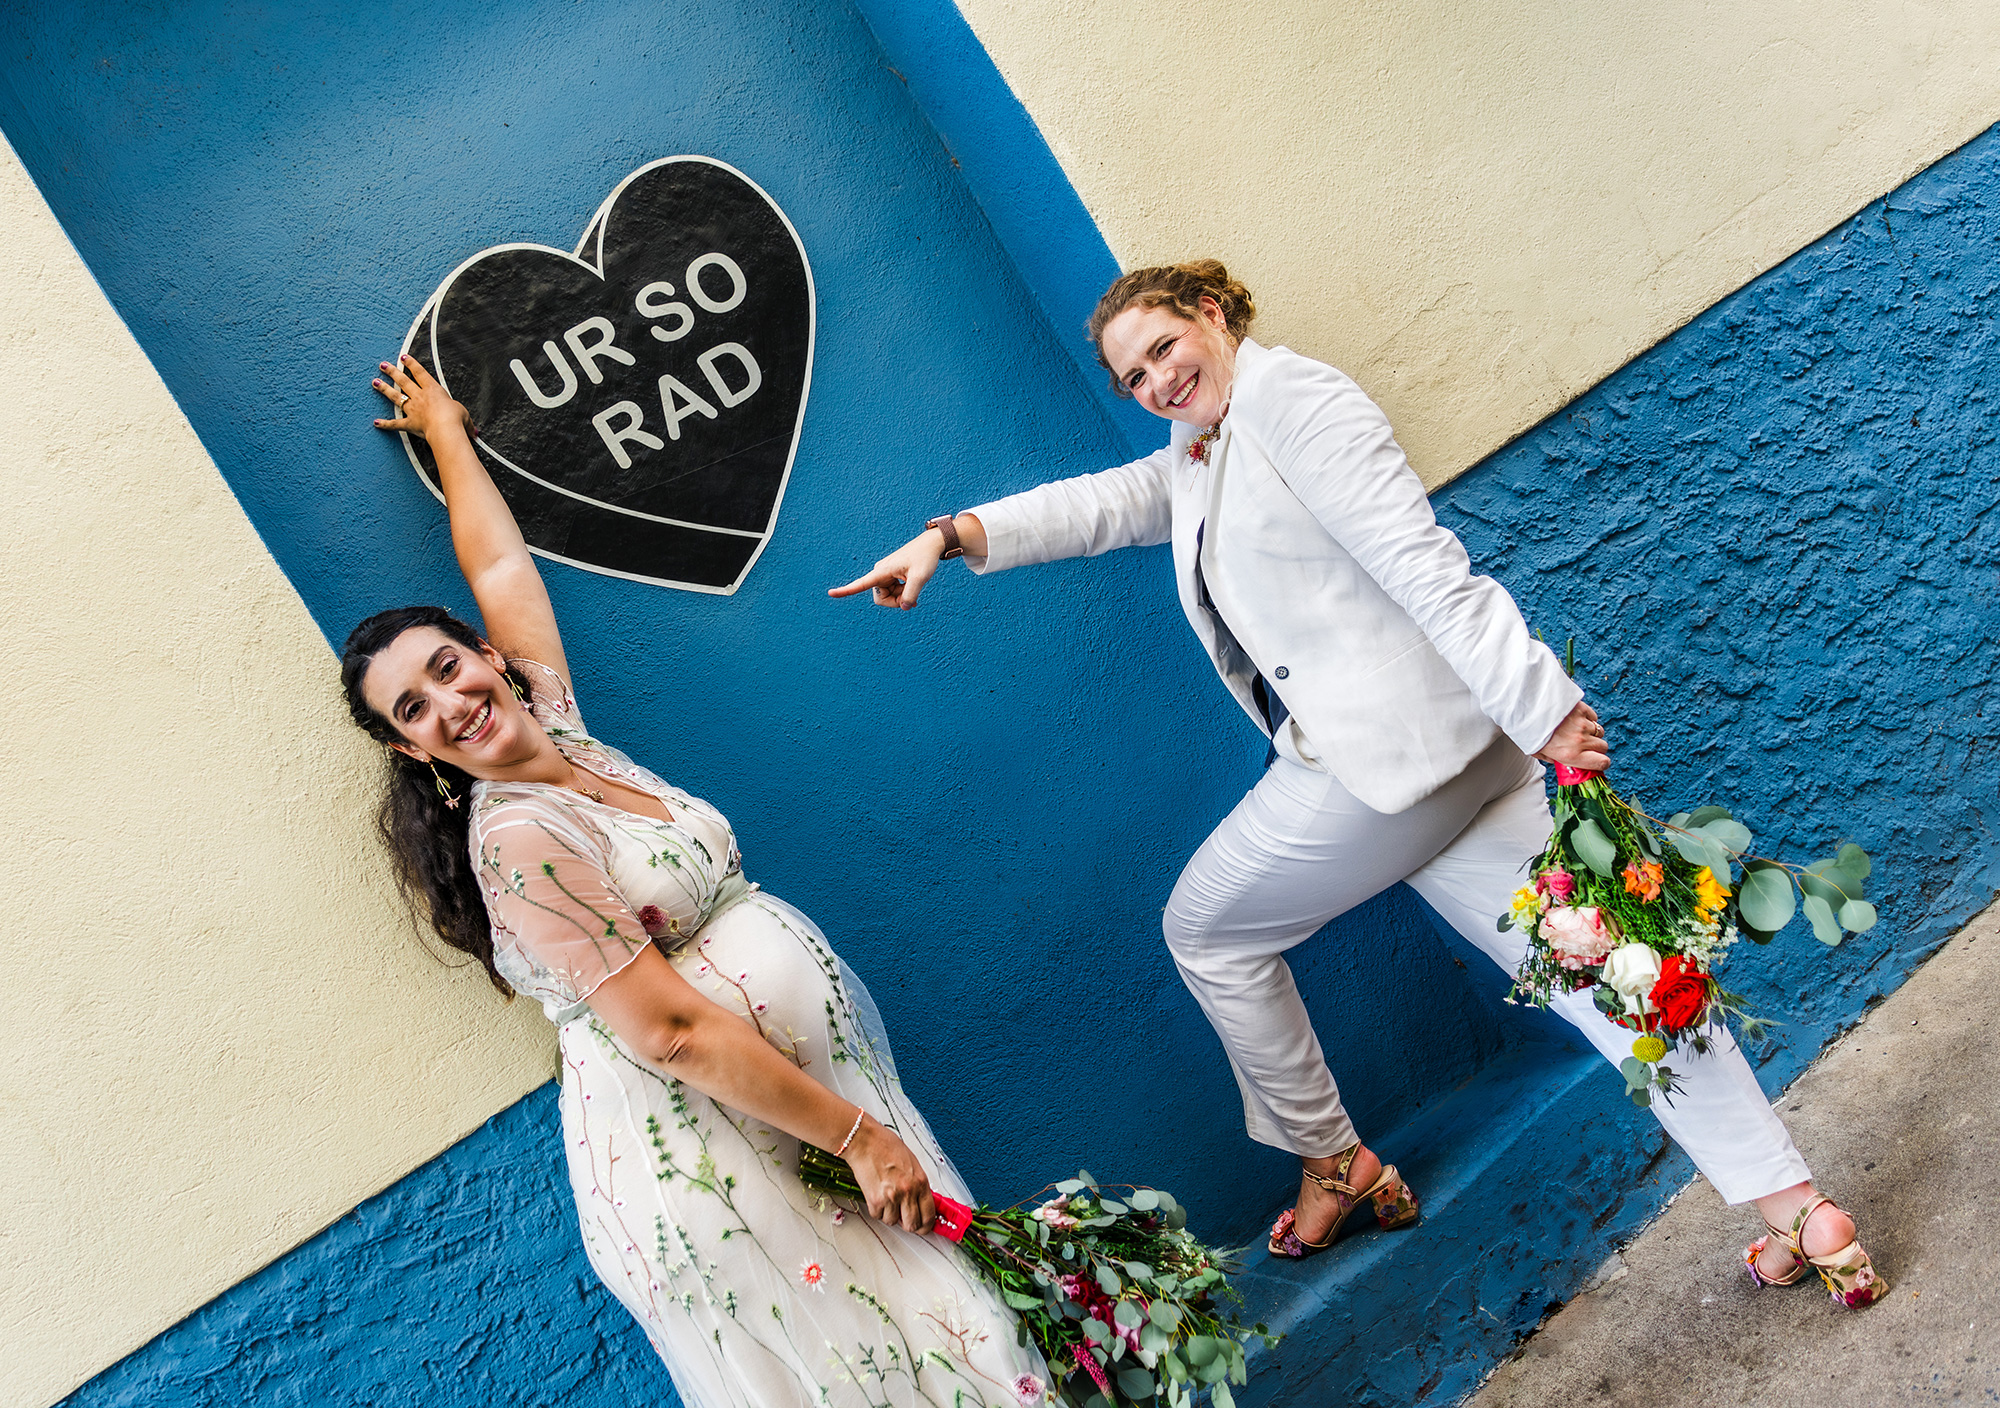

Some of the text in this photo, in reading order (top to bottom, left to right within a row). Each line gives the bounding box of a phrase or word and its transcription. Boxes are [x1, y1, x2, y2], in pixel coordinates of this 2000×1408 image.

[510, 252, 747, 409] UR SO
[592, 342, 762, 470] RAD
